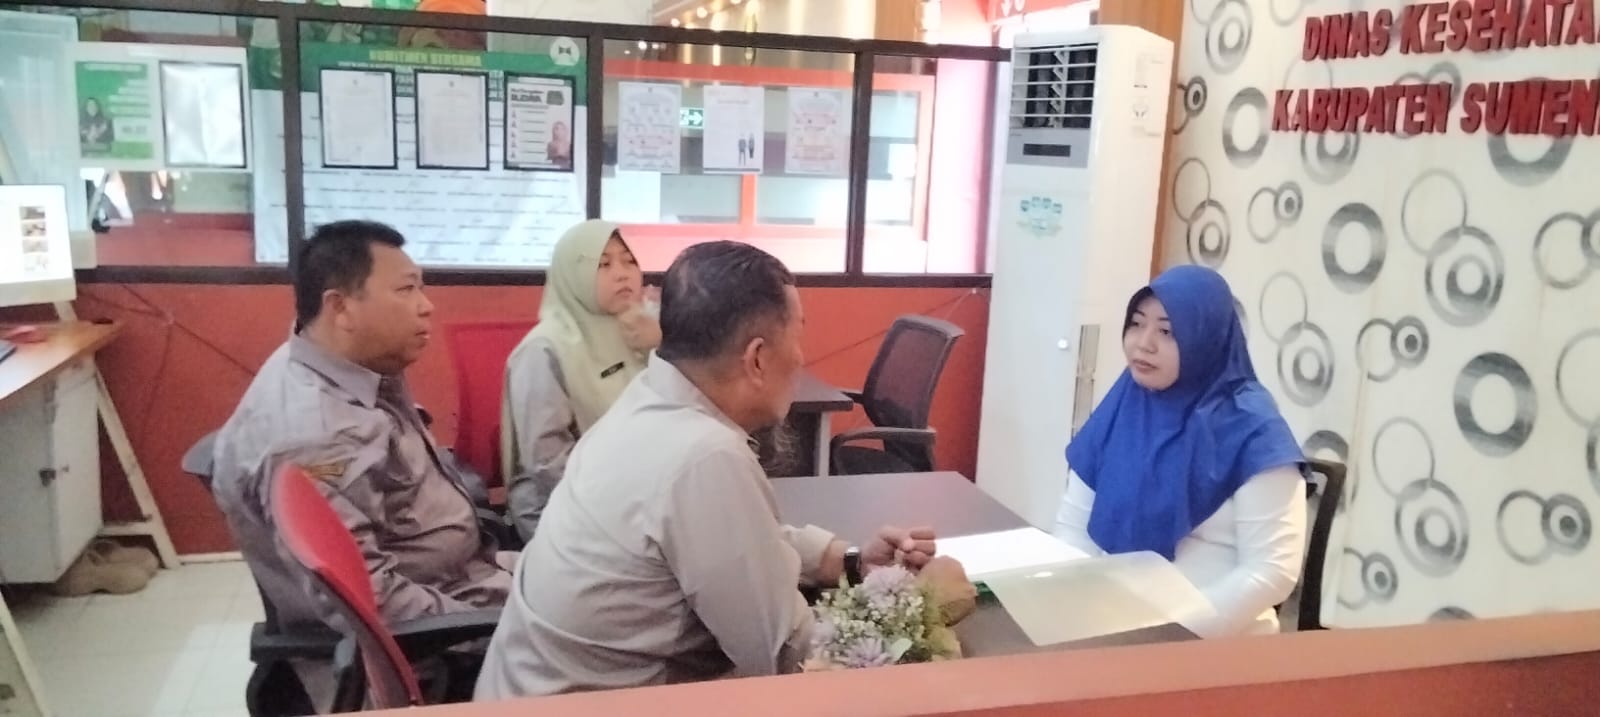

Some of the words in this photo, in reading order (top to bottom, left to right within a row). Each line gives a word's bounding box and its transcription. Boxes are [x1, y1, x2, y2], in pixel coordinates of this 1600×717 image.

[1302, 10, 1392, 60] DINAS
[1400, 0, 1600, 54] KESEHATA
[1271, 83, 1452, 133] KABUPATEN
[1460, 79, 1600, 137] SUMEN
